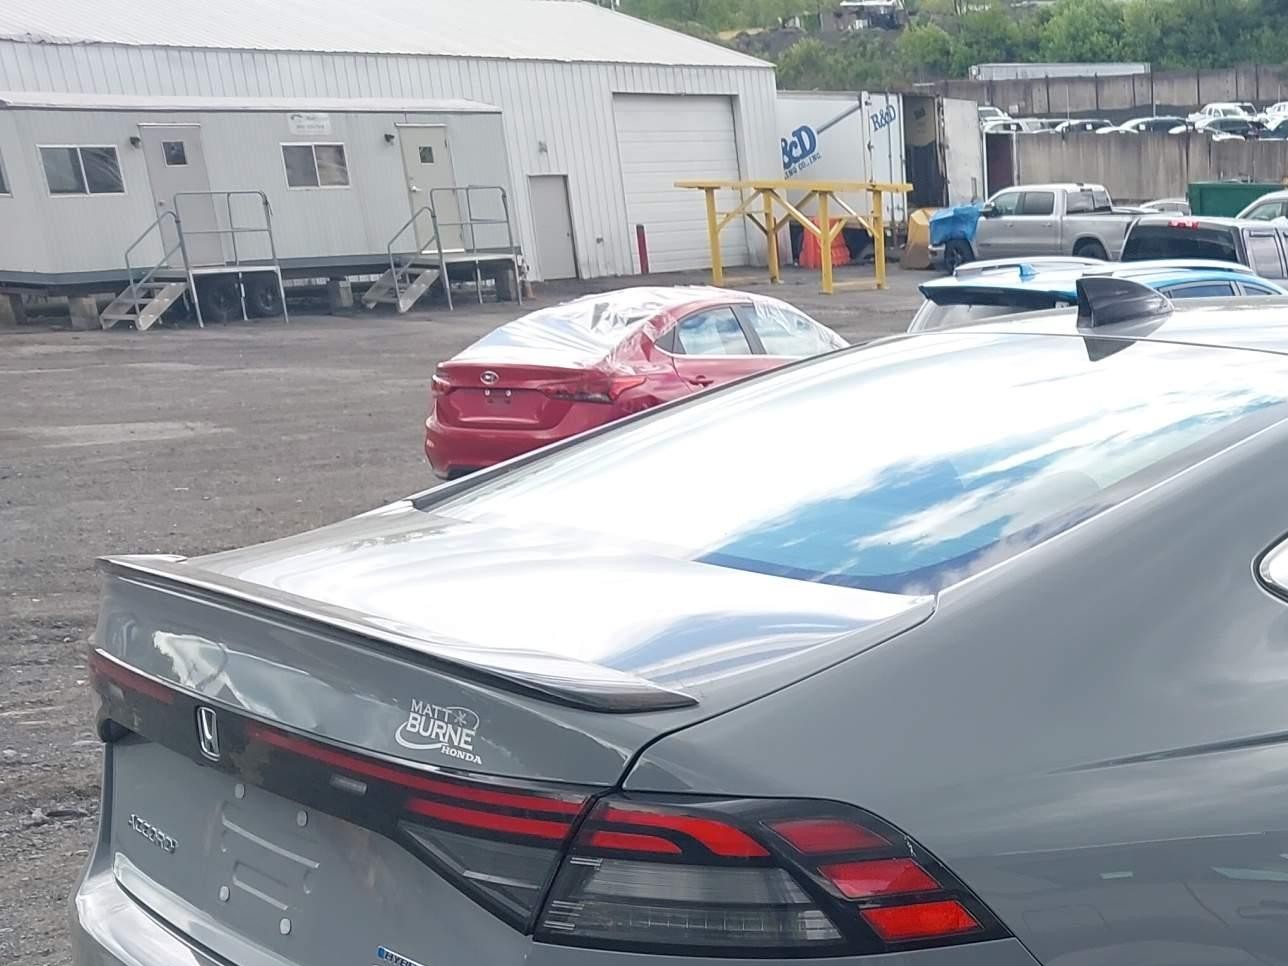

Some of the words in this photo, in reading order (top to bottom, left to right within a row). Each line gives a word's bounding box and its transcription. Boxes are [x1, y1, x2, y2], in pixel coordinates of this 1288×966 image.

[870, 104, 897, 132] R&D
[411, 698, 453, 723] MATT
[406, 711, 476, 752] BURNE
[440, 745, 482, 765] HONDA
[128, 813, 179, 853] ACCORD
